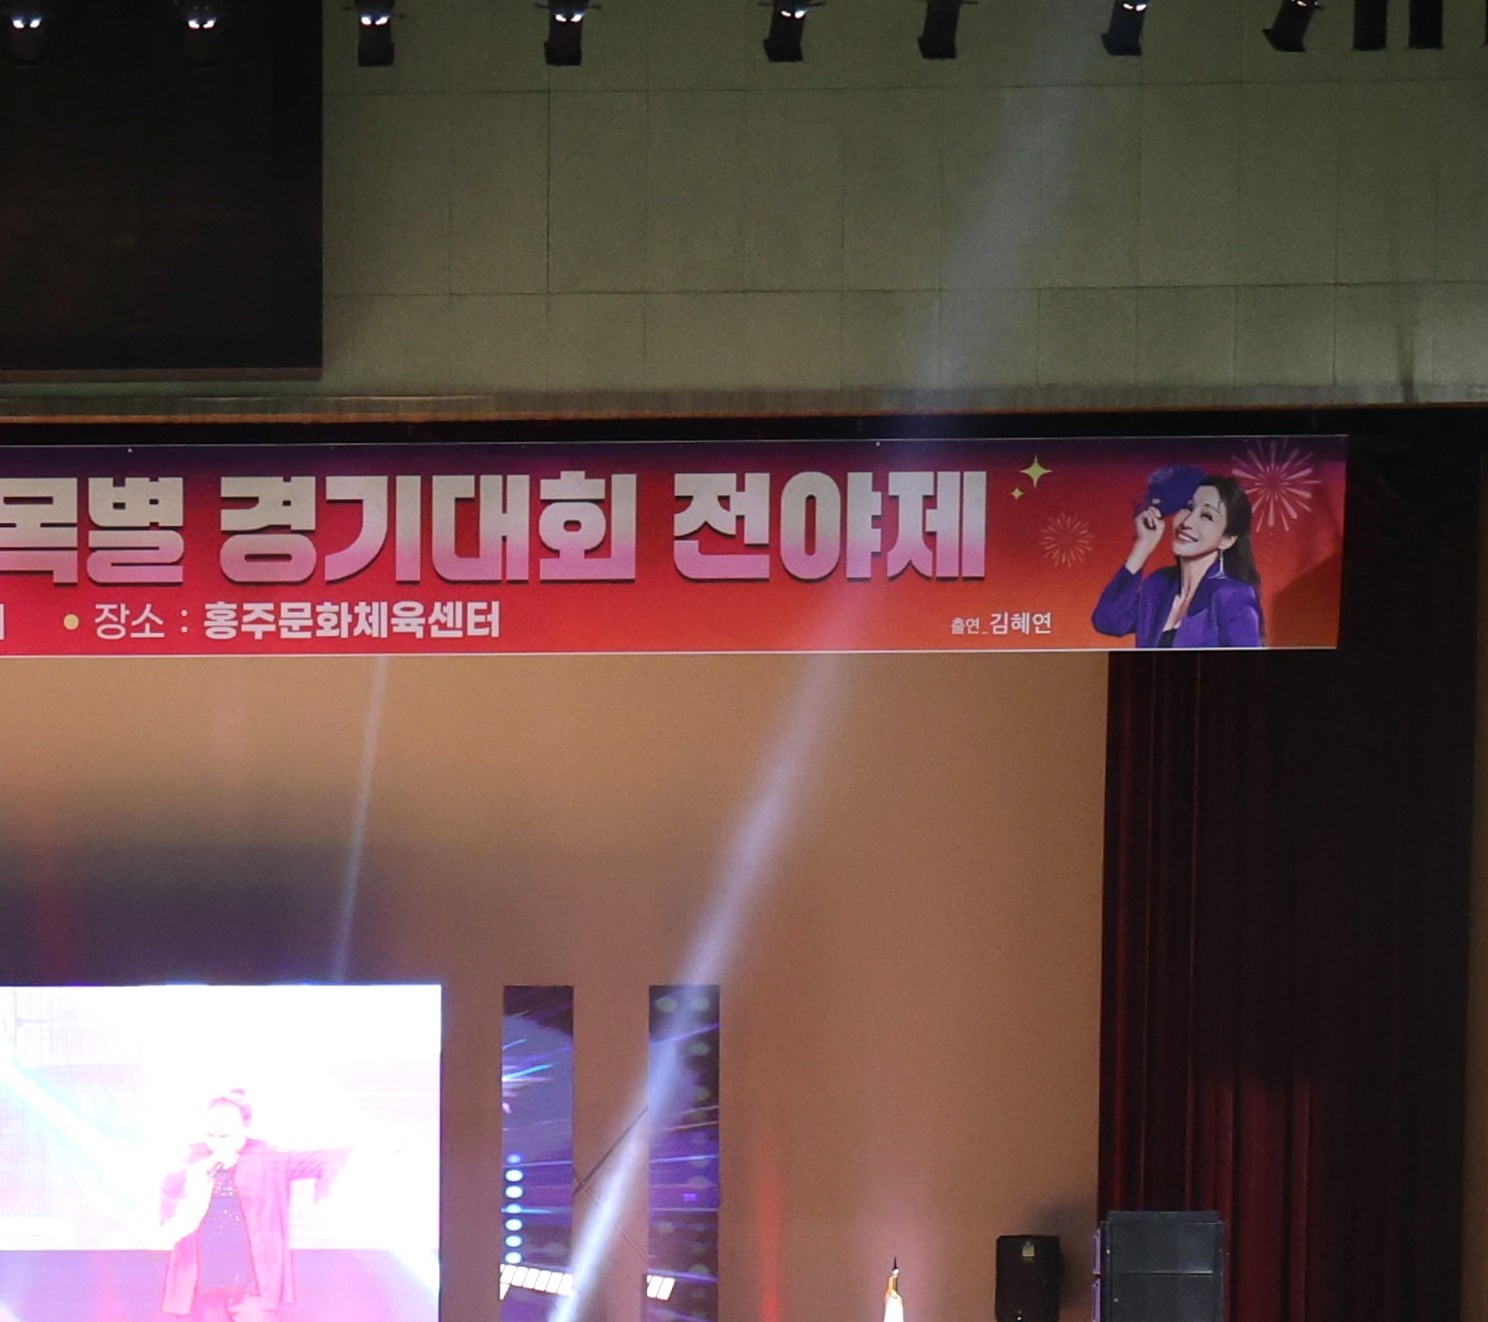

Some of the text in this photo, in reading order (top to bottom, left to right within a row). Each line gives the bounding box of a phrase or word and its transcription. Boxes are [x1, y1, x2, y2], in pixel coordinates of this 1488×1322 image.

[219, 470, 637, 584] 경기대회
[673, 470, 987, 580] 전야제
[94, 602, 166, 640] 장소
[202, 600, 501, 639] 홍주문화체육센터
